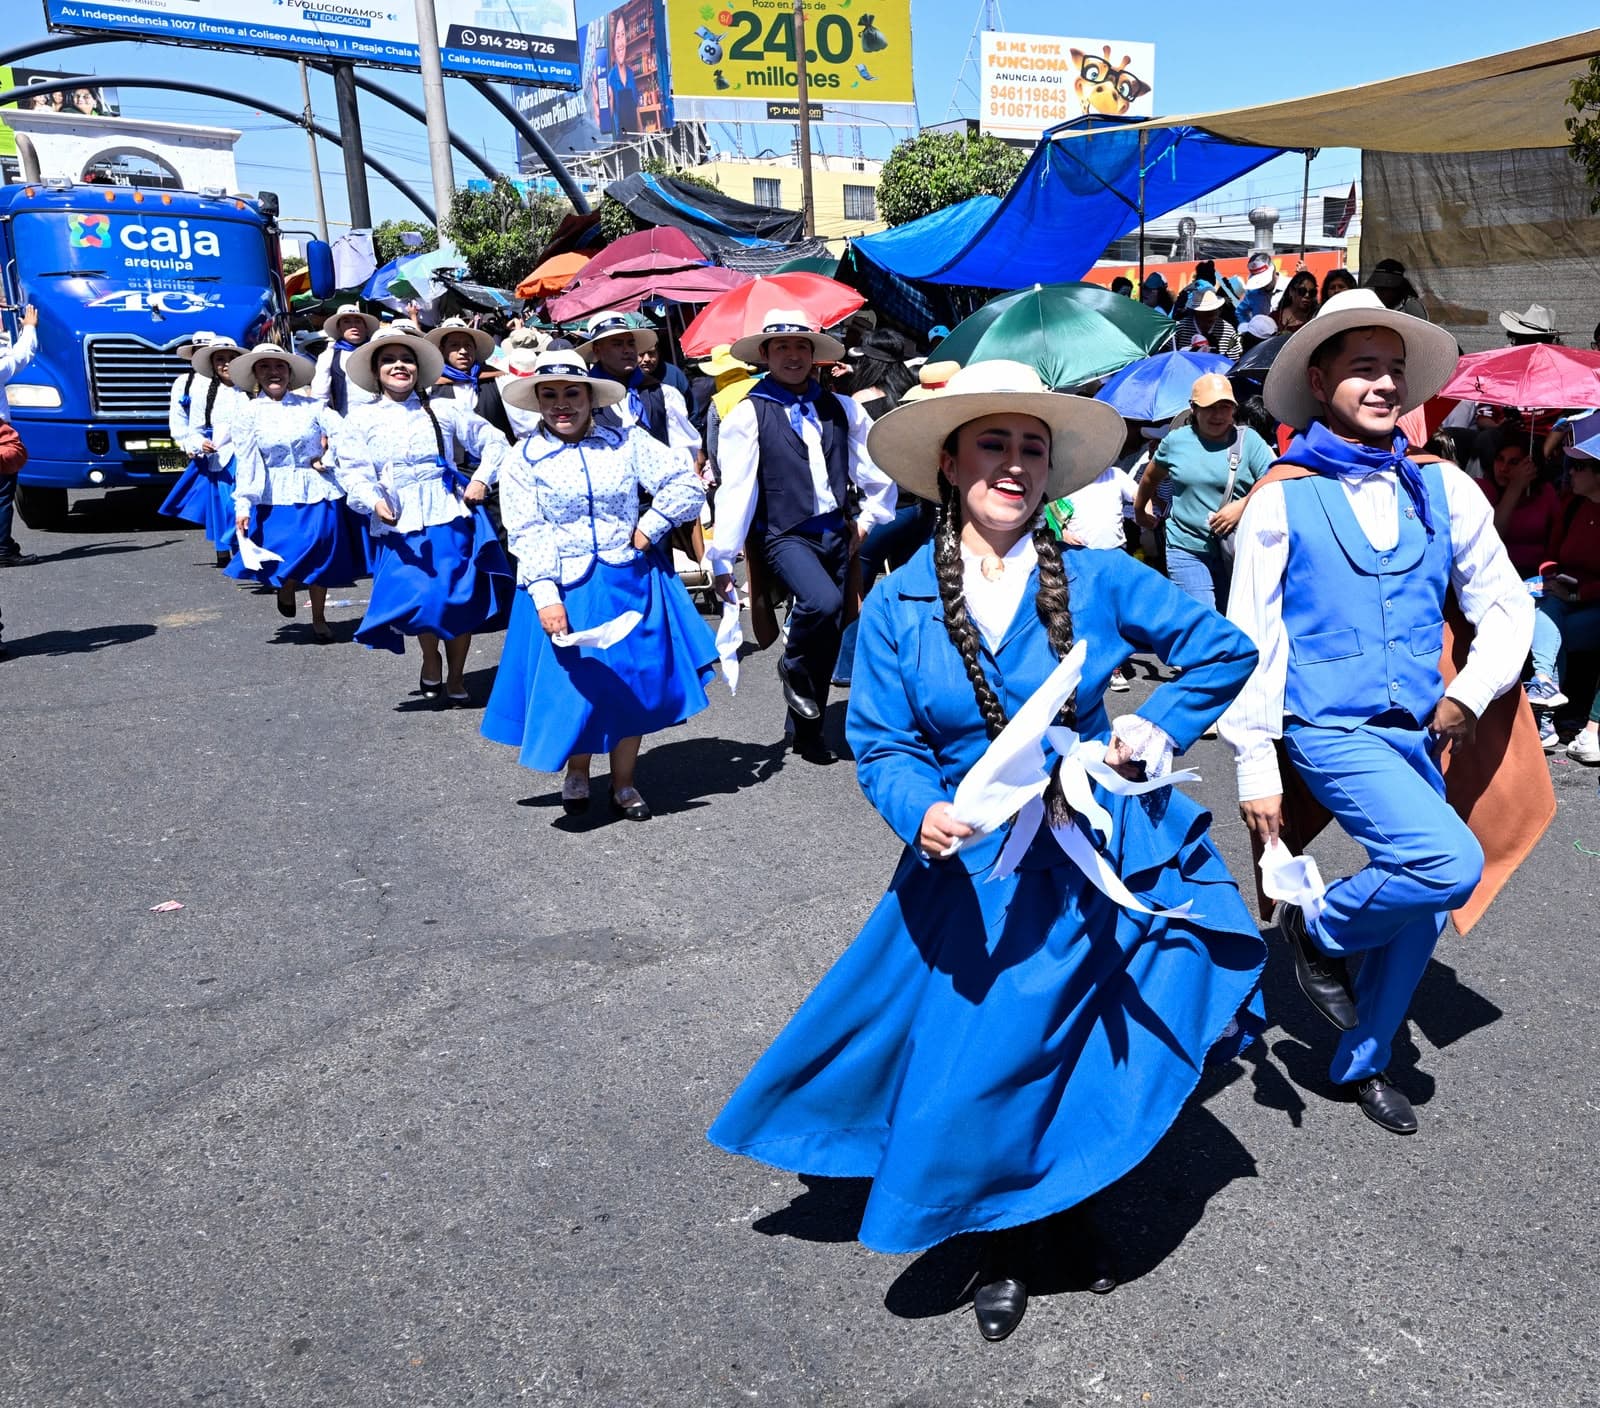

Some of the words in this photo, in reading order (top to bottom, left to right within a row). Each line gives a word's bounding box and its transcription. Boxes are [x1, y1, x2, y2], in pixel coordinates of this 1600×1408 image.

[287, 0, 384, 19] EVOLUCIONAMOS
[306, 10, 318, 19] EN
[752, 0, 775, 8] Pozo
[814, 2, 827, 10] de
[61, 6, 80, 17] Av.
[82, 8, 169, 28] Independencia
[171, 19, 196, 30] 1007
[199, 22, 235, 35] (frente
[238, 28, 247, 37] al
[249, 29, 287, 41] Coliseo
[289, 34, 339, 49] Arequipa)
[351, 42, 383, 54] Pasaje
[385, 46, 413, 57] Chala
[447, 54, 470, 64] Calle
[472, 57, 523, 70] Montesinos
[538, 65, 548, 74] La
[550, 66, 572, 76] Perla
[479, 34, 503, 48] 914
[505, 38, 529, 51] 299
[531, 41, 555, 54] 726
[728, 10, 853, 64] 24.0
[995, 41, 1007, 52] SI
[1010, 42, 1026, 53] ME
[1030, 44, 1061, 55] VISTE
[988, 54, 1069, 72] FUNCIONA
[995, 73, 1038, 82] ANUNCIA
[1040, 75, 1062, 84] AQUI
[515, 90, 534, 113] Cobra
[990, 85, 1067, 103] 946119843
[566, 94, 587, 120] BBVA
[990, 101, 1067, 120] 910671648
[120, 220, 220, 260] caja
[124, 257, 194, 272] arequipa
